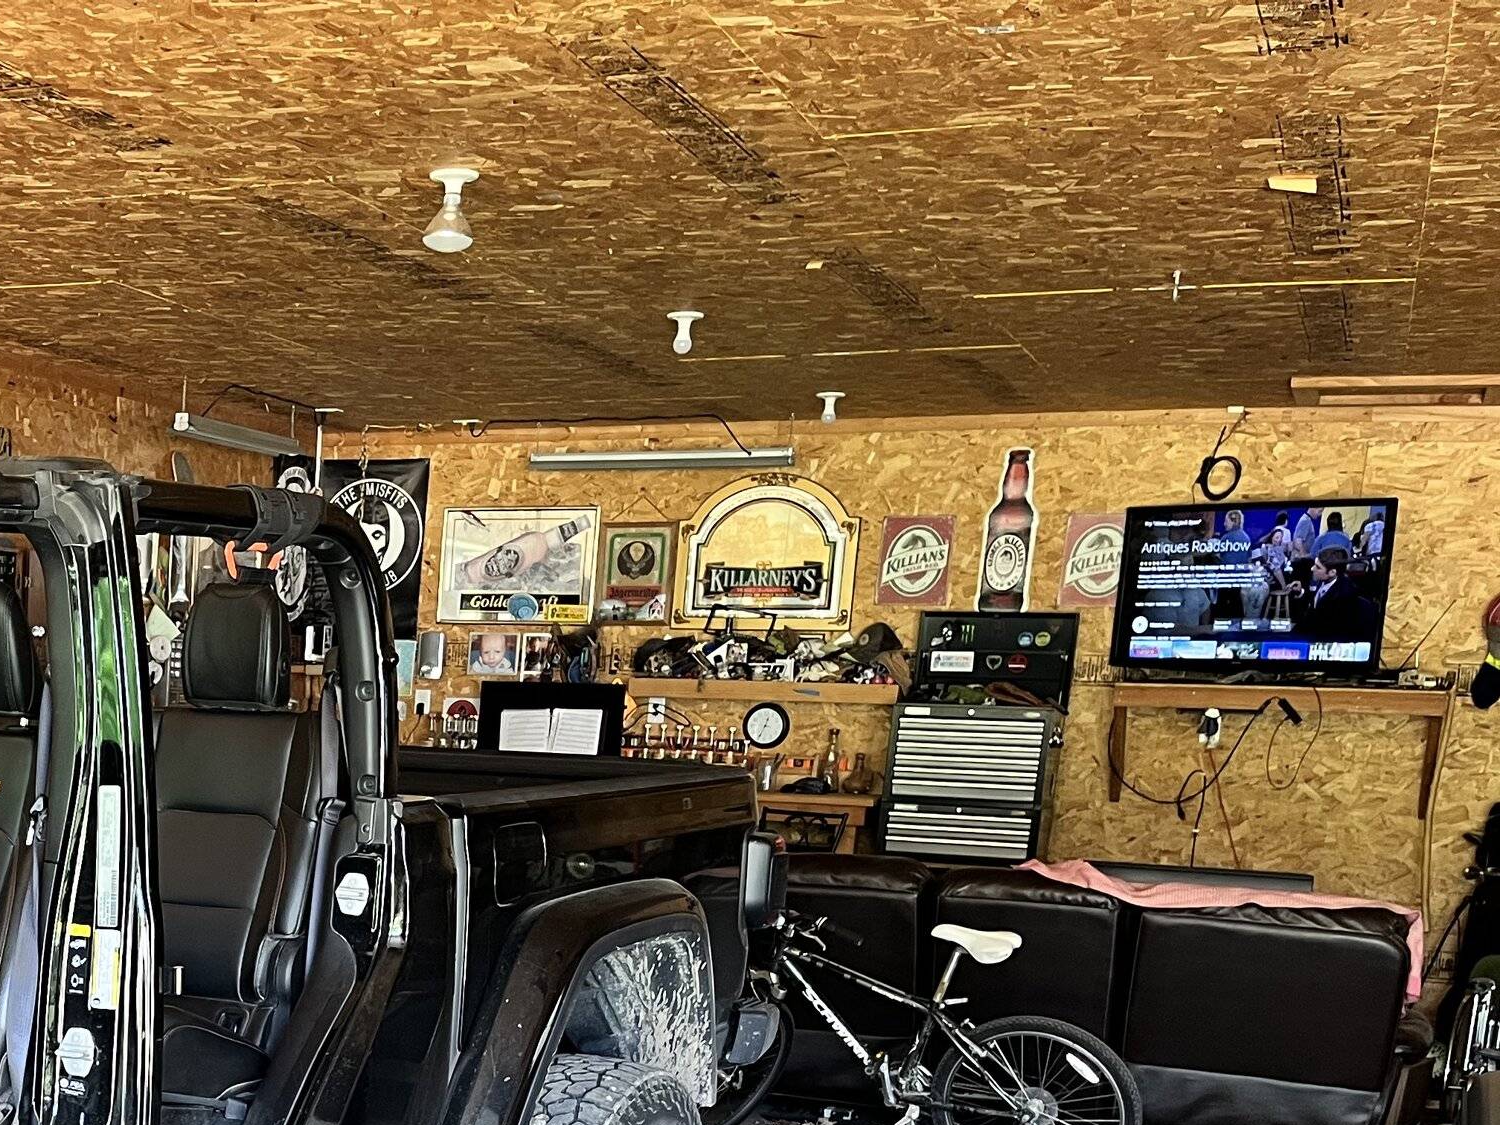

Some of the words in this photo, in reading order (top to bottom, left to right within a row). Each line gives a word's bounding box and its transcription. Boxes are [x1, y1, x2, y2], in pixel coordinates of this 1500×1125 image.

[334, 487, 358, 509] THE
[365, 482, 408, 510] MISFITS
[1141, 542, 1190, 555] Antiques
[1191, 540, 1251, 553] Roadshow
[709, 567, 818, 594] KILLARNEY'S
[469, 592, 510, 608] Golde
[801, 987, 871, 1066] SCHWINN
